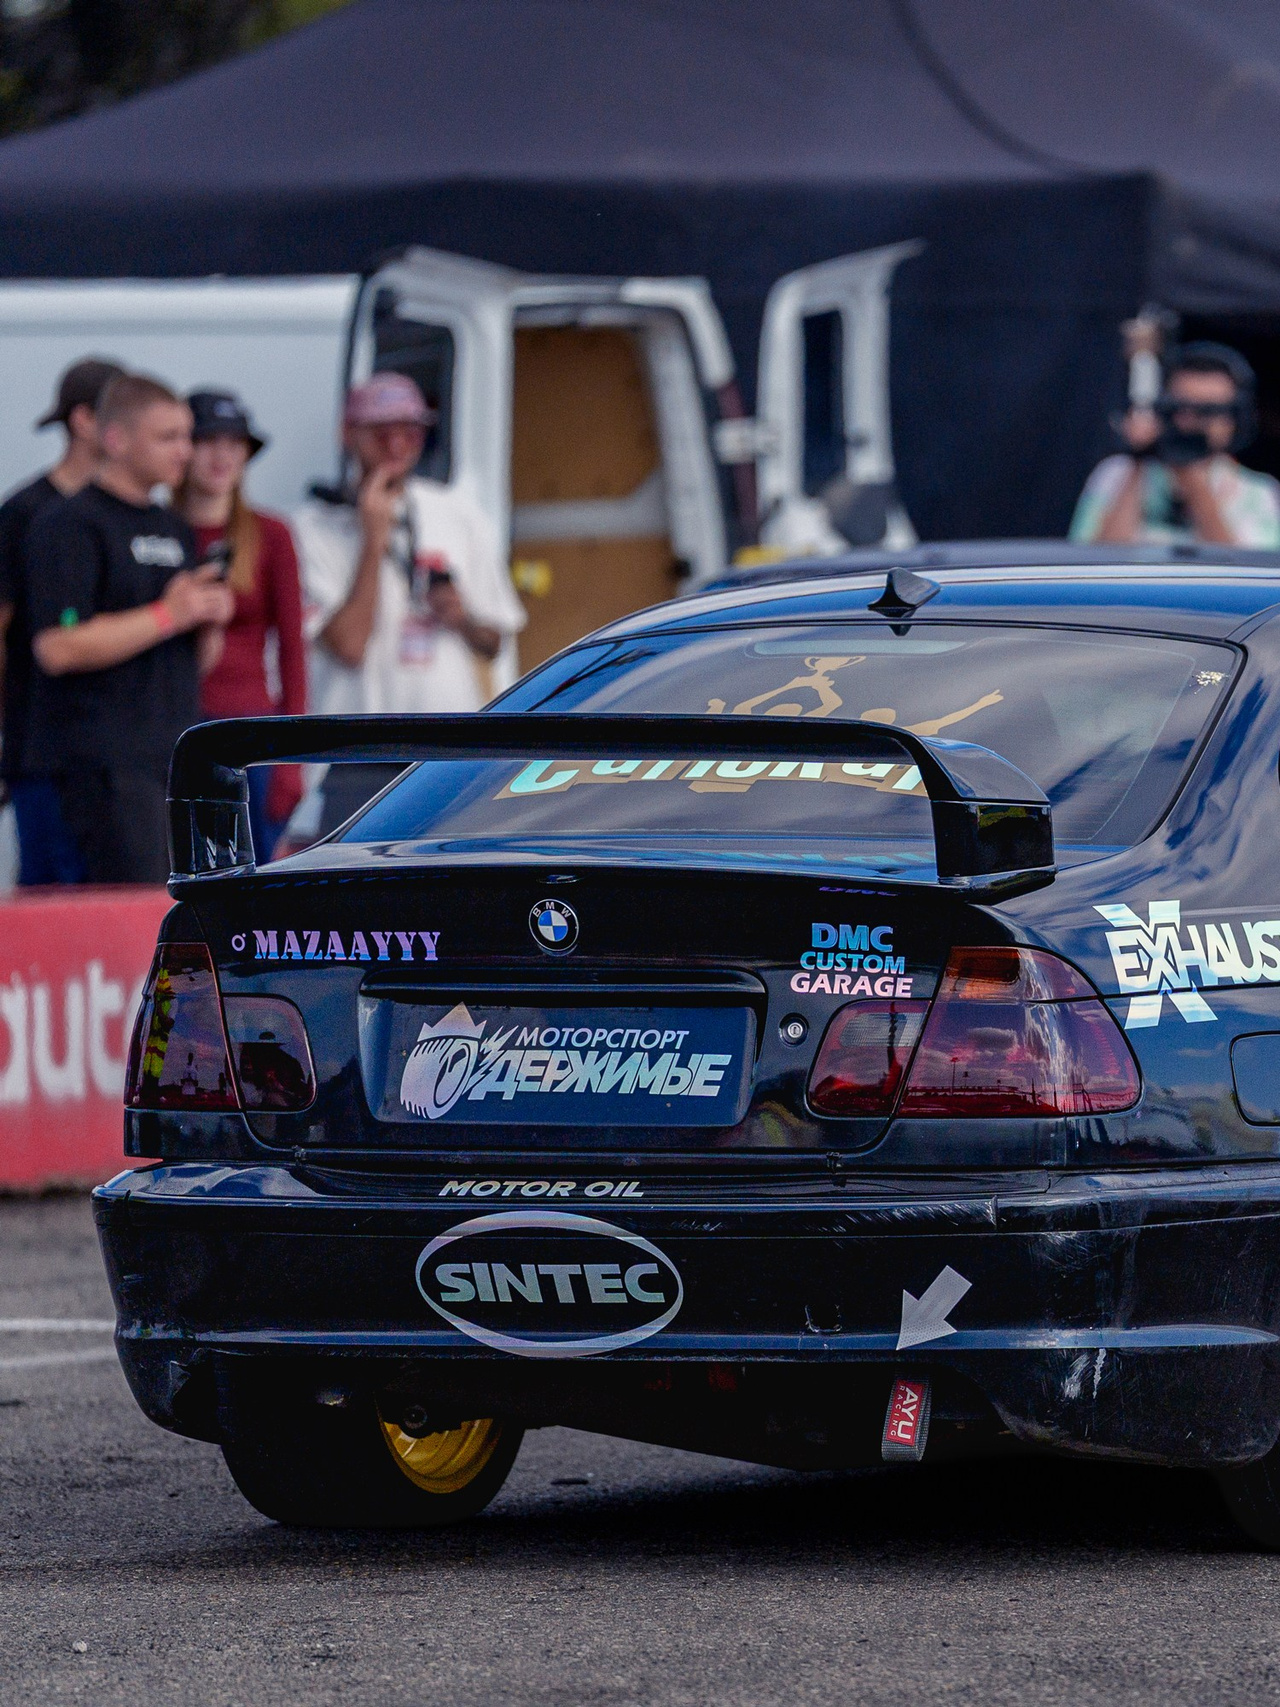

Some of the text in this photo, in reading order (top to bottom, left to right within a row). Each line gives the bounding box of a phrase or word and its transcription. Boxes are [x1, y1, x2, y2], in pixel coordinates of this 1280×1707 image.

[532, 901, 572, 919] BMW
[252, 929, 441, 961] MAZAAYYY
[811, 922, 894, 952] DMC
[799, 951, 906, 975] CUSTOM
[789, 972, 914, 998] GARAGE
[0, 960, 146, 1103] aut
[515, 1026, 689, 1050] МОТОРСПОРТ
[438, 1180, 646, 1197] MOTOR OIL
[435, 1262, 666, 1304] SINTEC
[897, 1387, 919, 1440] AYU
